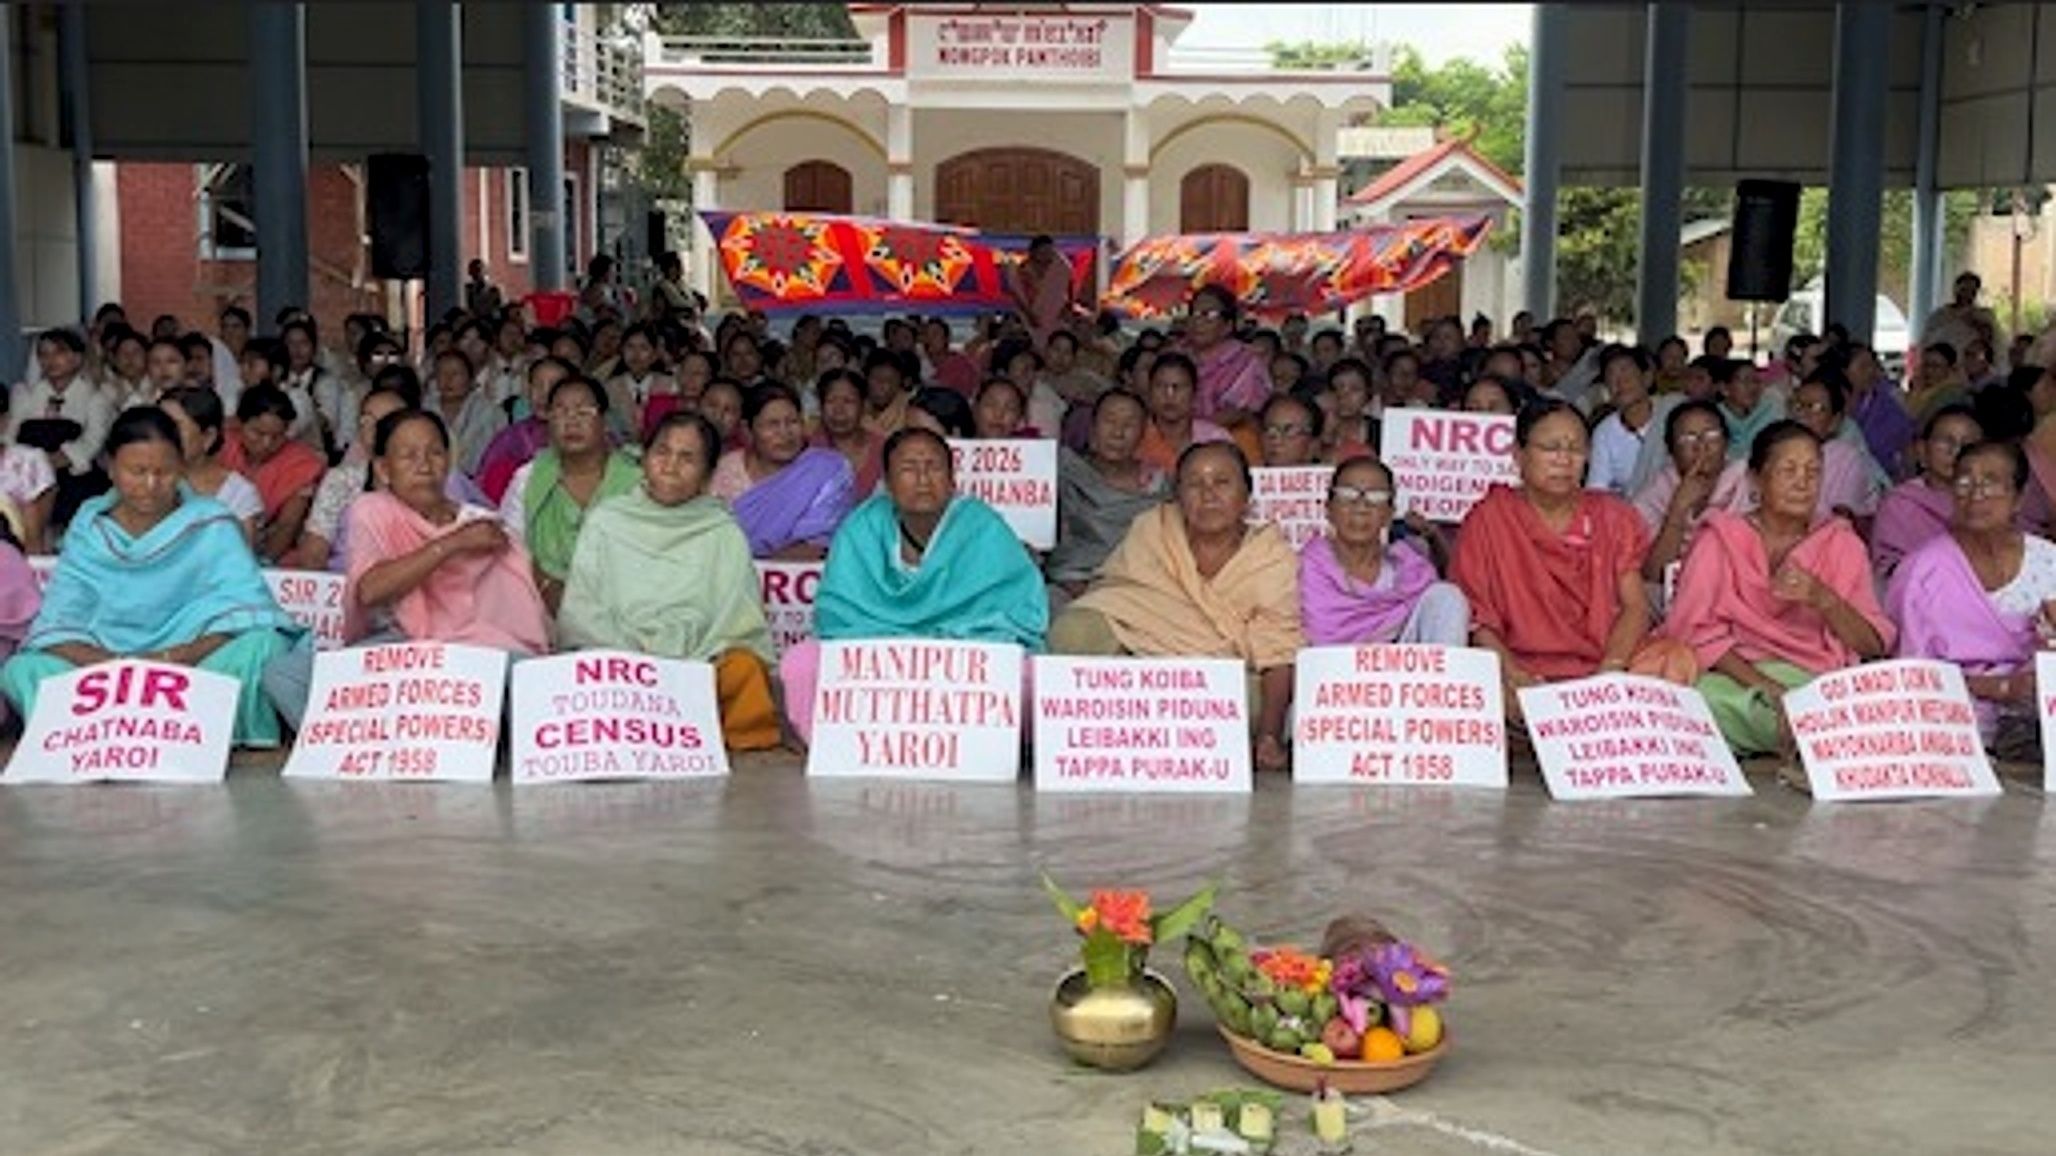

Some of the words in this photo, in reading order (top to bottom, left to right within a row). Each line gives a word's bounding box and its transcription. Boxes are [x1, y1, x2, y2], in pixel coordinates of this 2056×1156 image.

[1411, 418, 1514, 455] NRC
[971, 446, 1022, 472] 2026
[280, 578, 317, 604] SIR
[364, 646, 445, 673] REMOVE
[576, 659, 658, 687] NRC
[839, 646, 990, 683] MANIPUR
[1355, 648, 1446, 673] REMOVE
[72, 666, 189, 716] SIR
[1073, 668, 1133, 688] TUNG
[1140, 669, 1208, 689] KOIBA
[325, 682, 391, 712] ARMED
[395, 679, 482, 707] FORCES
[552, 690, 681, 718] TOUDANA
[817, 688, 1016, 727] MUTTHATPA
[1041, 698, 1150, 719] WAROISIN
[1157, 699, 1241, 720] PIDUNA
[1315, 683, 1394, 709] ARMED
[1400, 683, 1486, 711] FORCES
[1558, 683, 1621, 710] TUNG
[43, 717, 202, 750] CHATNABA
[535, 718, 703, 748] CENSUS
[1067, 728, 1170, 748] LEIBAKKI
[1177, 729, 1216, 748] ING
[71, 747, 158, 771] YAROI
[339, 751, 383, 774] ACT
[388, 748, 438, 773] 1958
[857, 731, 959, 768] YAROI
[523, 752, 620, 776] TOUBA
[631, 752, 718, 772] YAROI
[1056, 757, 1125, 777] TAPPA
[1132, 758, 1230, 779] PURAK-U
[1351, 753, 1394, 777] ACT
[1402, 753, 1454, 780] 1958
